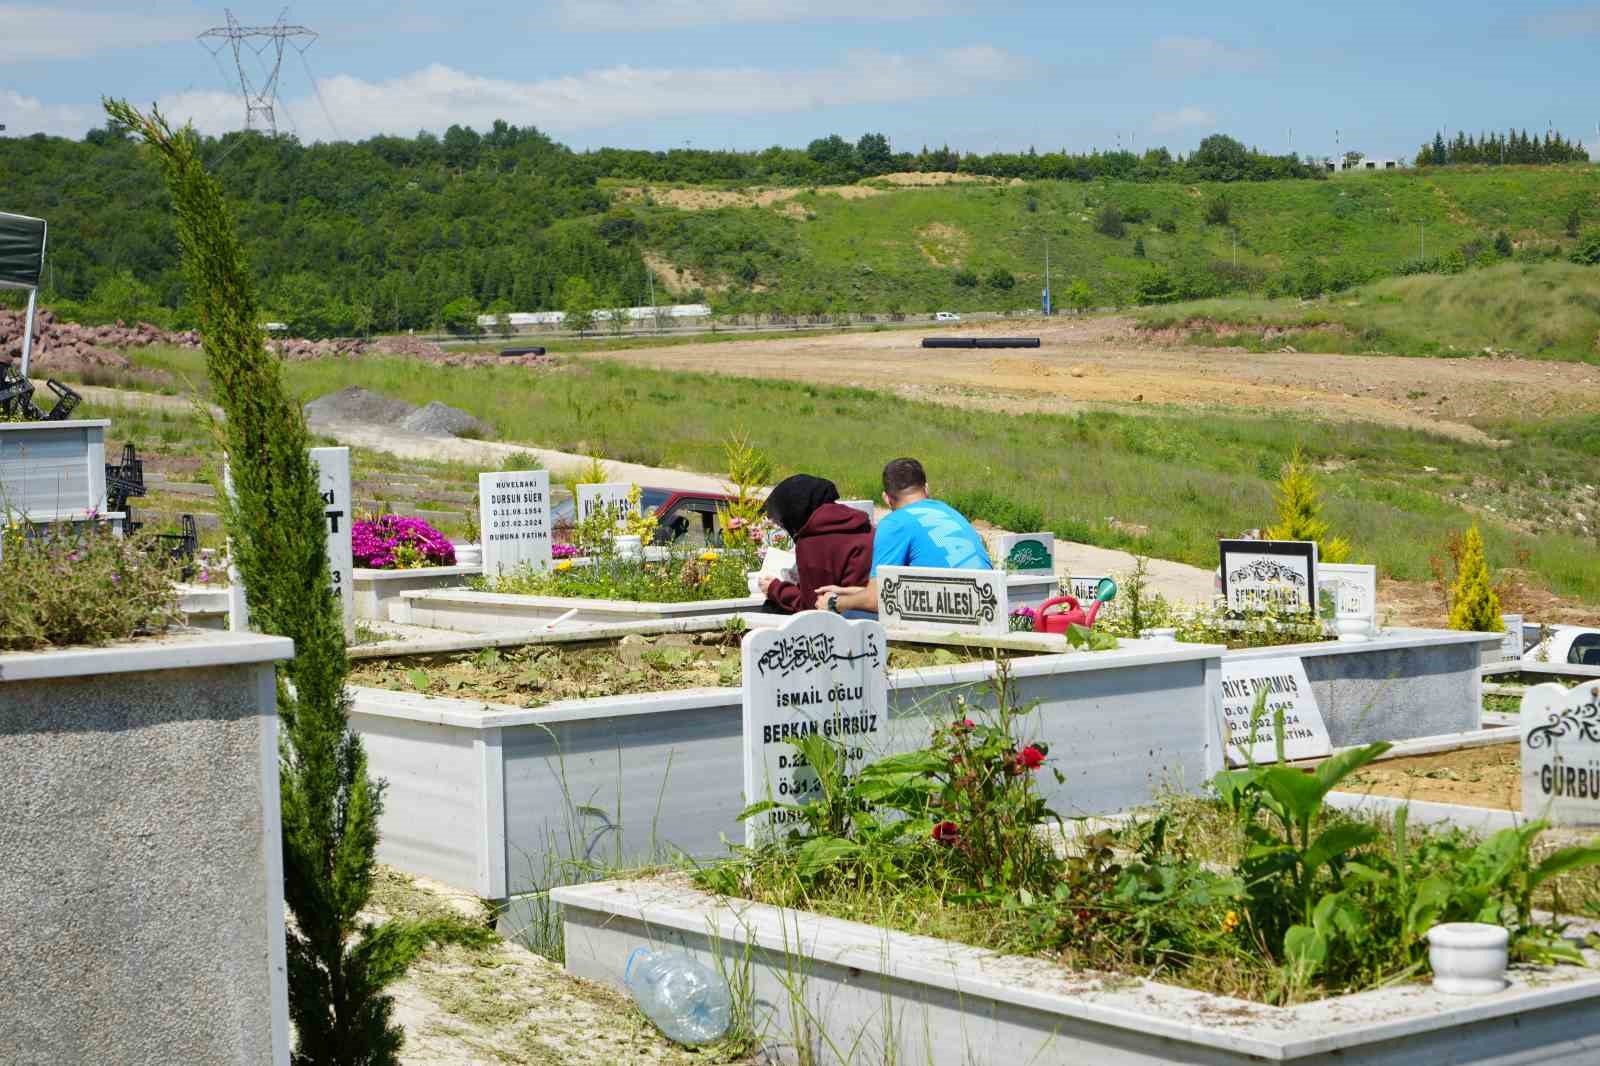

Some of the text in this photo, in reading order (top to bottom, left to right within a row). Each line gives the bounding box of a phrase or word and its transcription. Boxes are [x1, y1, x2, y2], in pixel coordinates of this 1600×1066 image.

[491, 494, 521, 504] DURSUN
[489, 533, 519, 541] RUHUNA
[903, 586, 973, 615] ÜZEL AİLESİ
[777, 683, 863, 707] İSMAİL OĞLU
[1221, 675, 1250, 698] RİYE
[763, 709, 878, 744] BERKAN GÜRBÜZ
